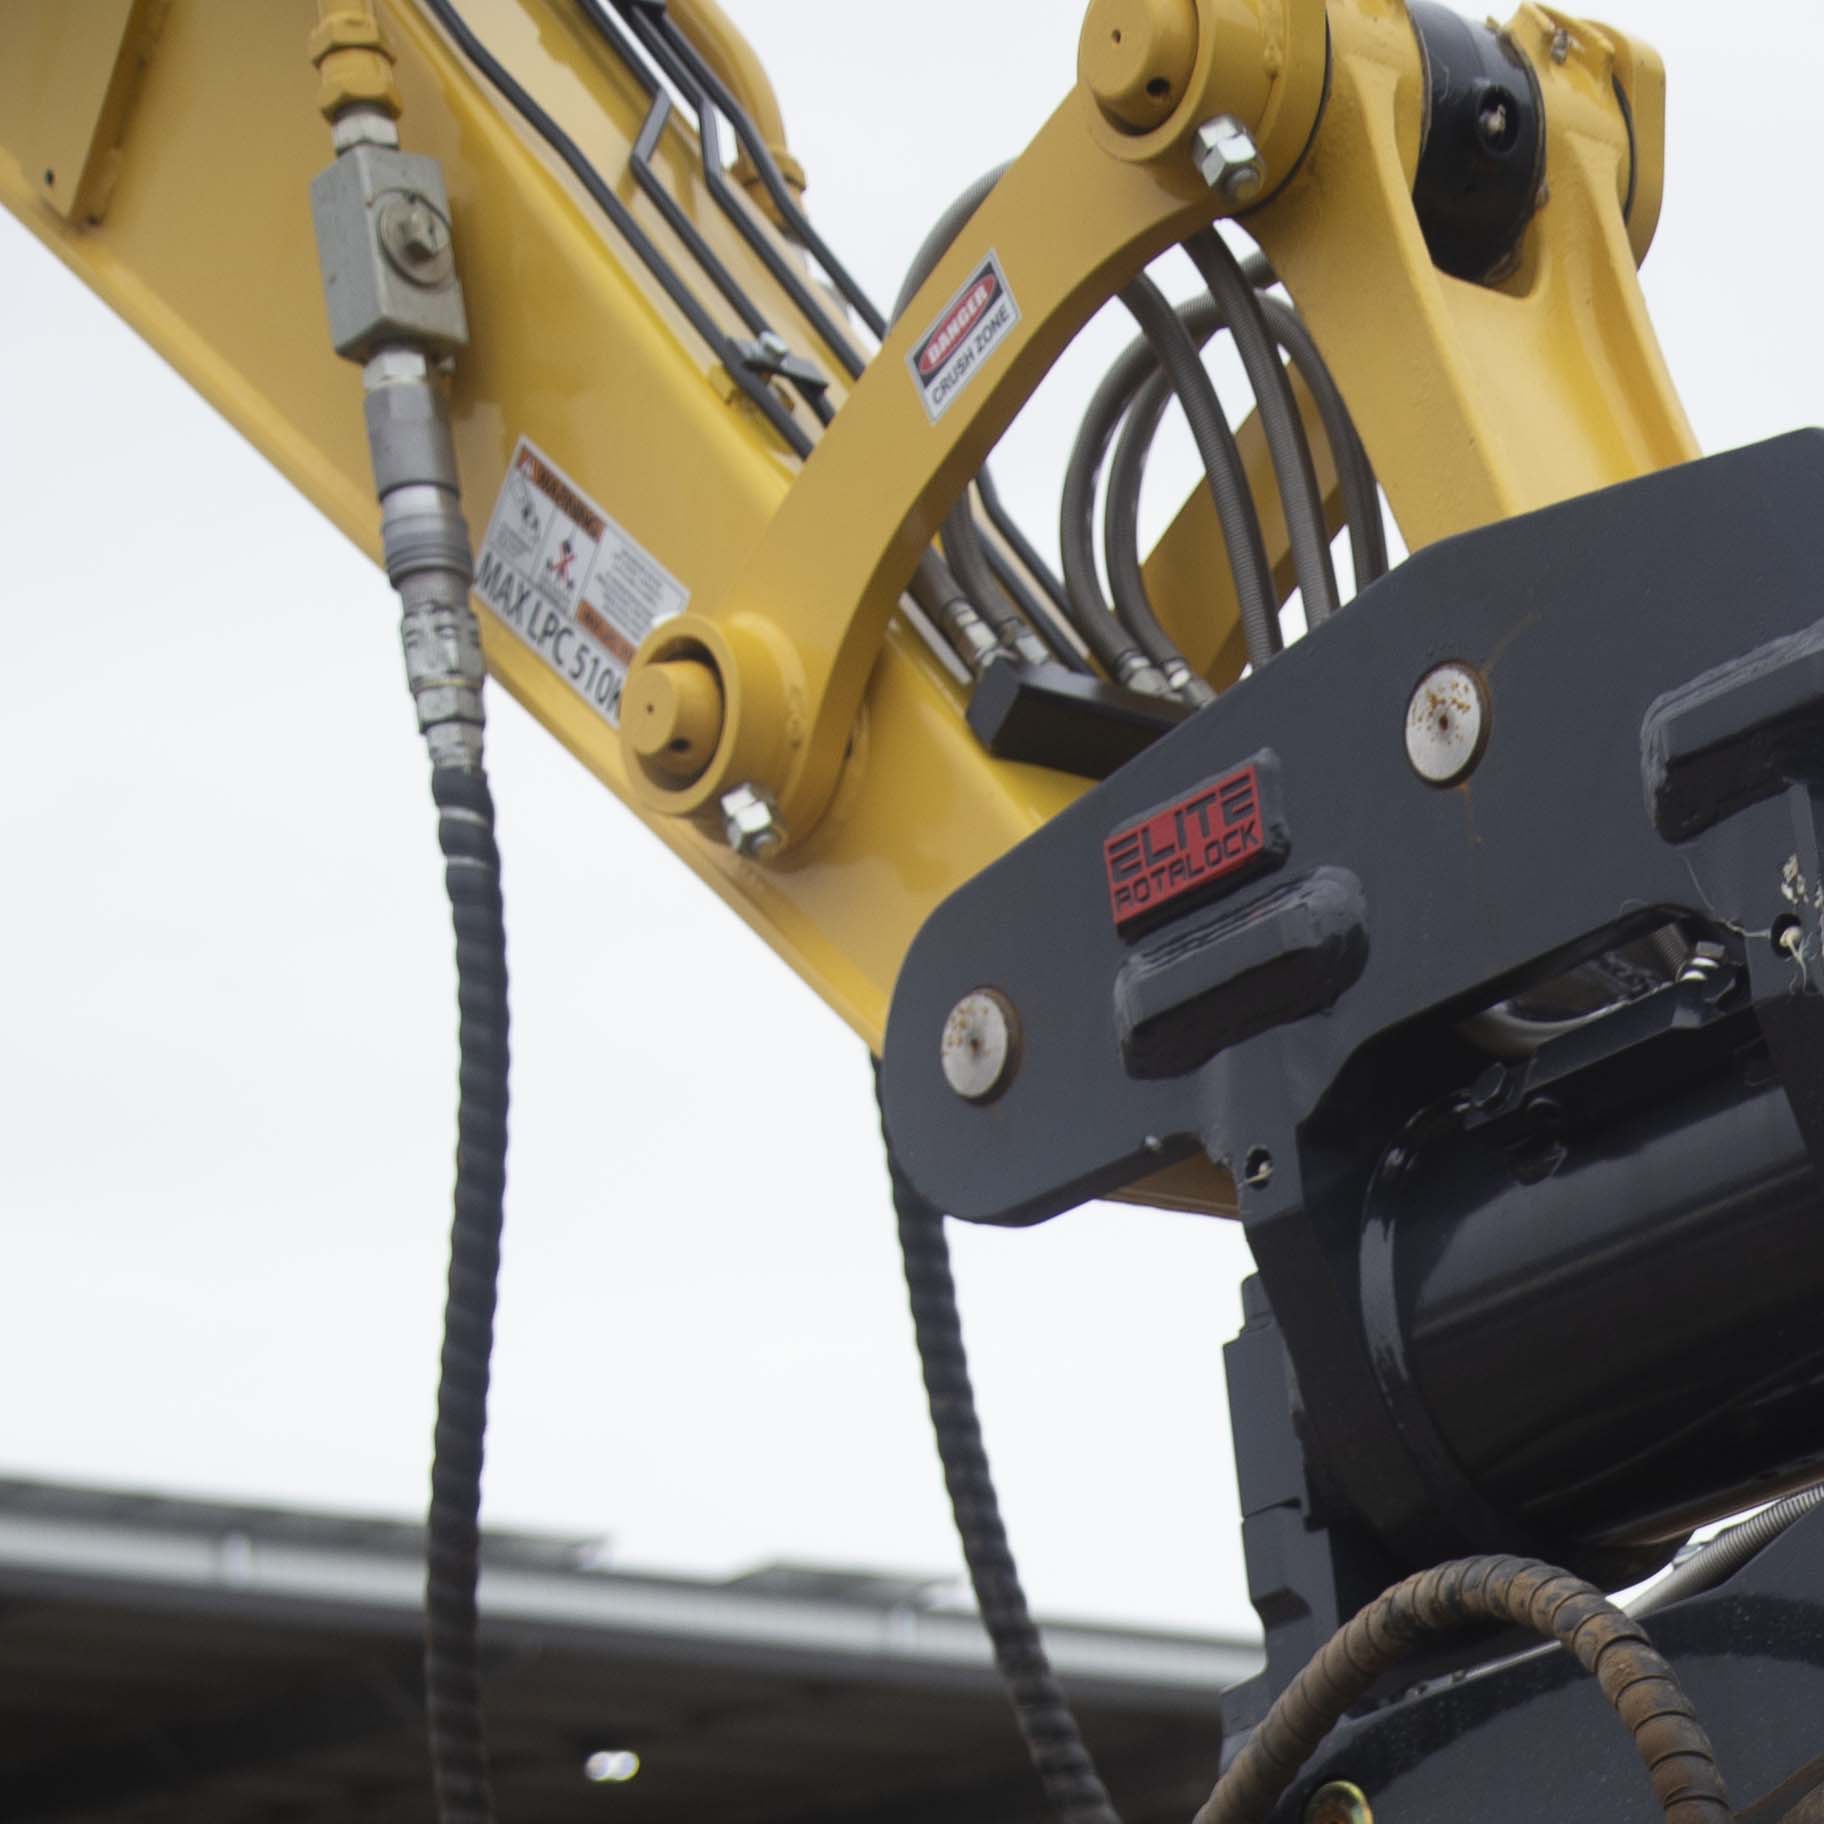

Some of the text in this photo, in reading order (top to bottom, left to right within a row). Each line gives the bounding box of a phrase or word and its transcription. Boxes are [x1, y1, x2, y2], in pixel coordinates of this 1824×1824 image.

[927, 285, 988, 365] DANGER
[932, 303, 1010, 404] CRUSH ZONE
[477, 552, 531, 626] MAX
[527, 604, 576, 668] LPC
[1108, 773, 1256, 883] ELITE
[1114, 819, 1258, 912] ROTALOCK
